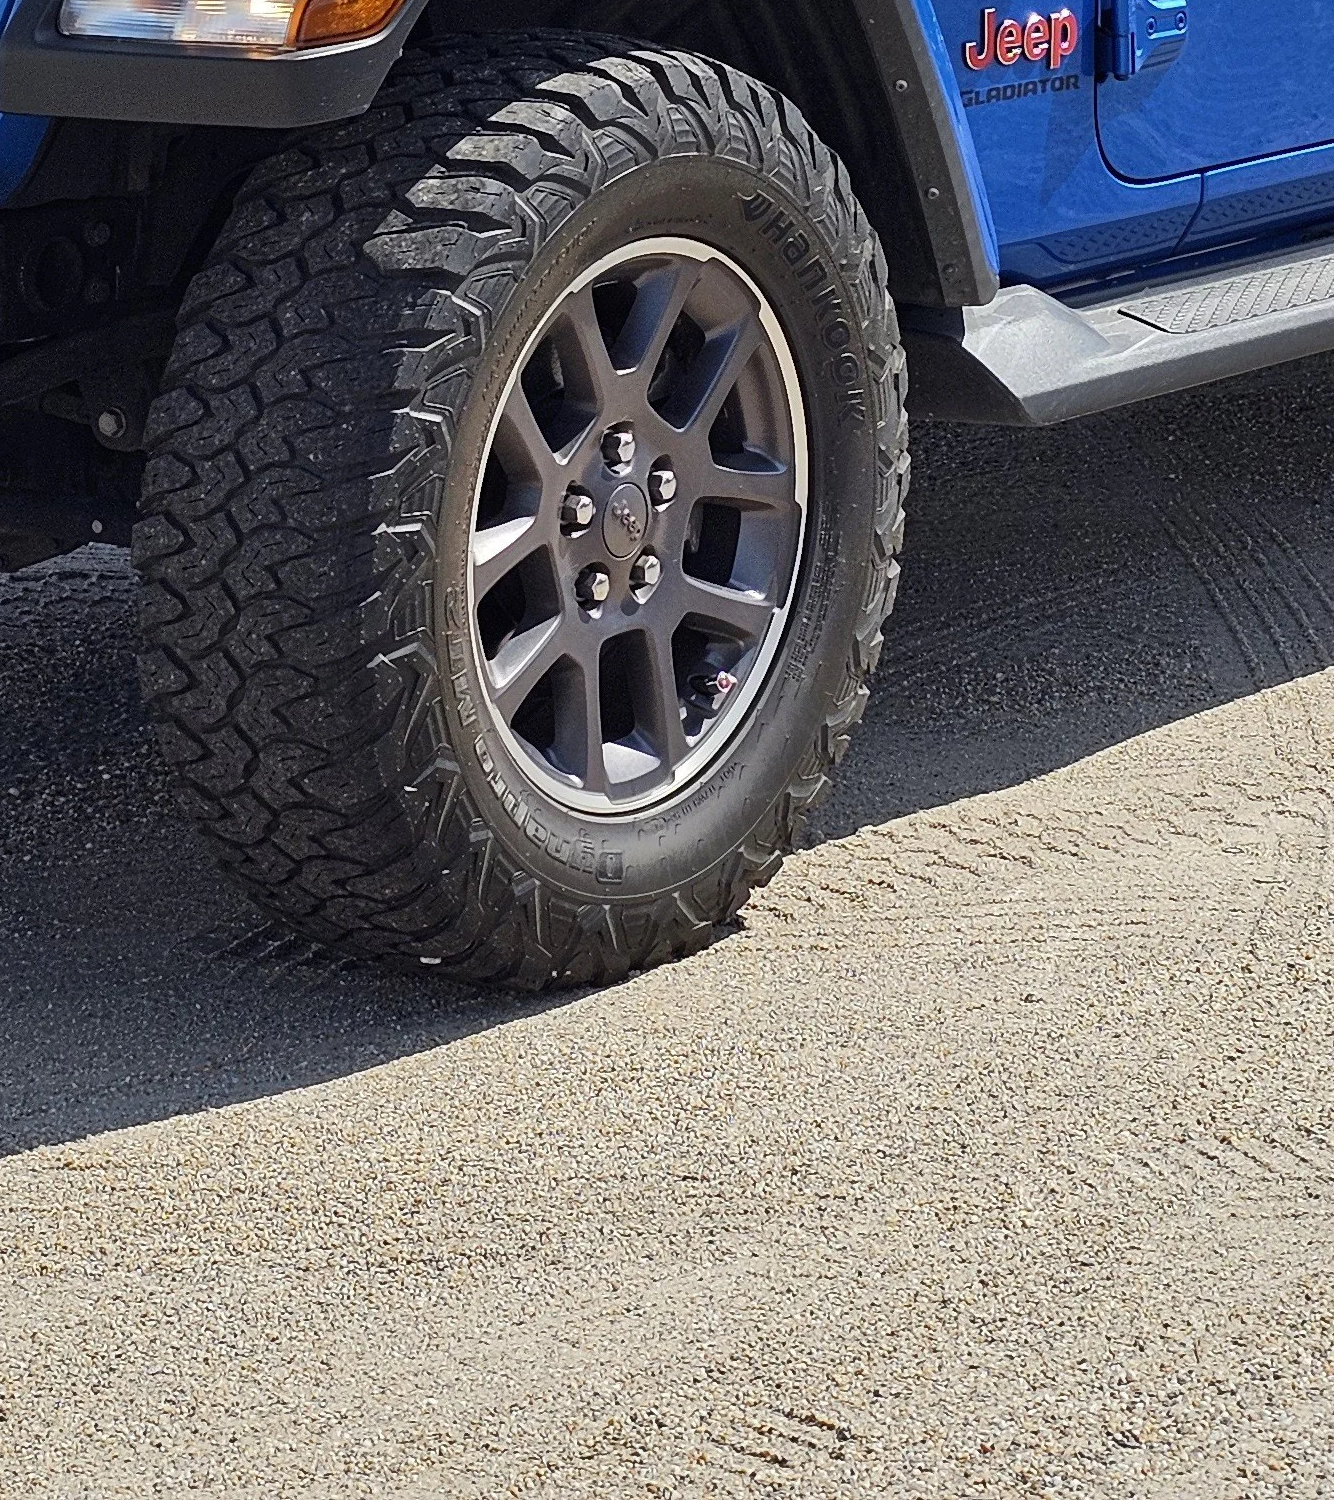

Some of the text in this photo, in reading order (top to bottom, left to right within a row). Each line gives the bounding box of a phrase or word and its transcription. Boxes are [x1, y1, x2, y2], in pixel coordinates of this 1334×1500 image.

[962, 7, 1078, 70] Jeep
[960, 75, 1081, 108] GLADIATOR
[473, 733, 624, 886] Dynapro
